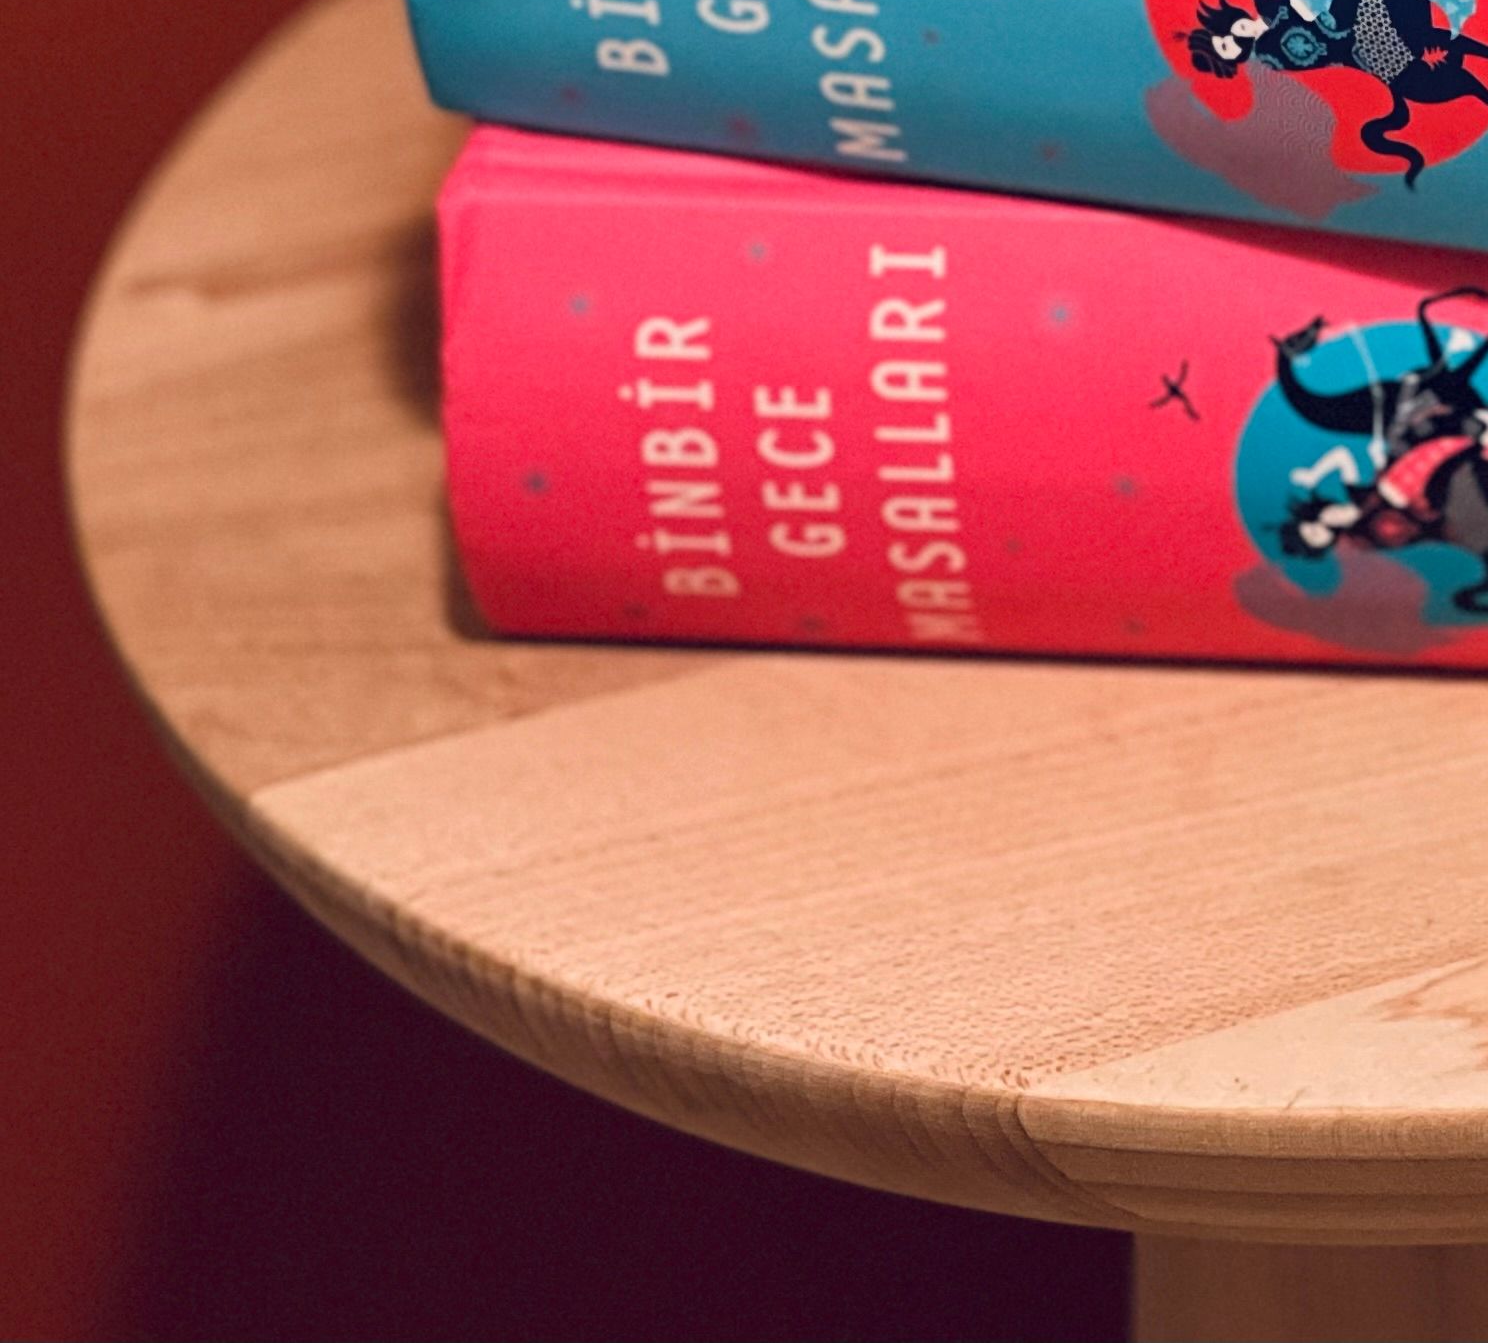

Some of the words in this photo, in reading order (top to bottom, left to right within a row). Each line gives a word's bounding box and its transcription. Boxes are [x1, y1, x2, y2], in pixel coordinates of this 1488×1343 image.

[617, 317, 741, 599] BİNBİR
[753, 384, 846, 559] GECE
[868, 244, 986, 642] MASALLARI
